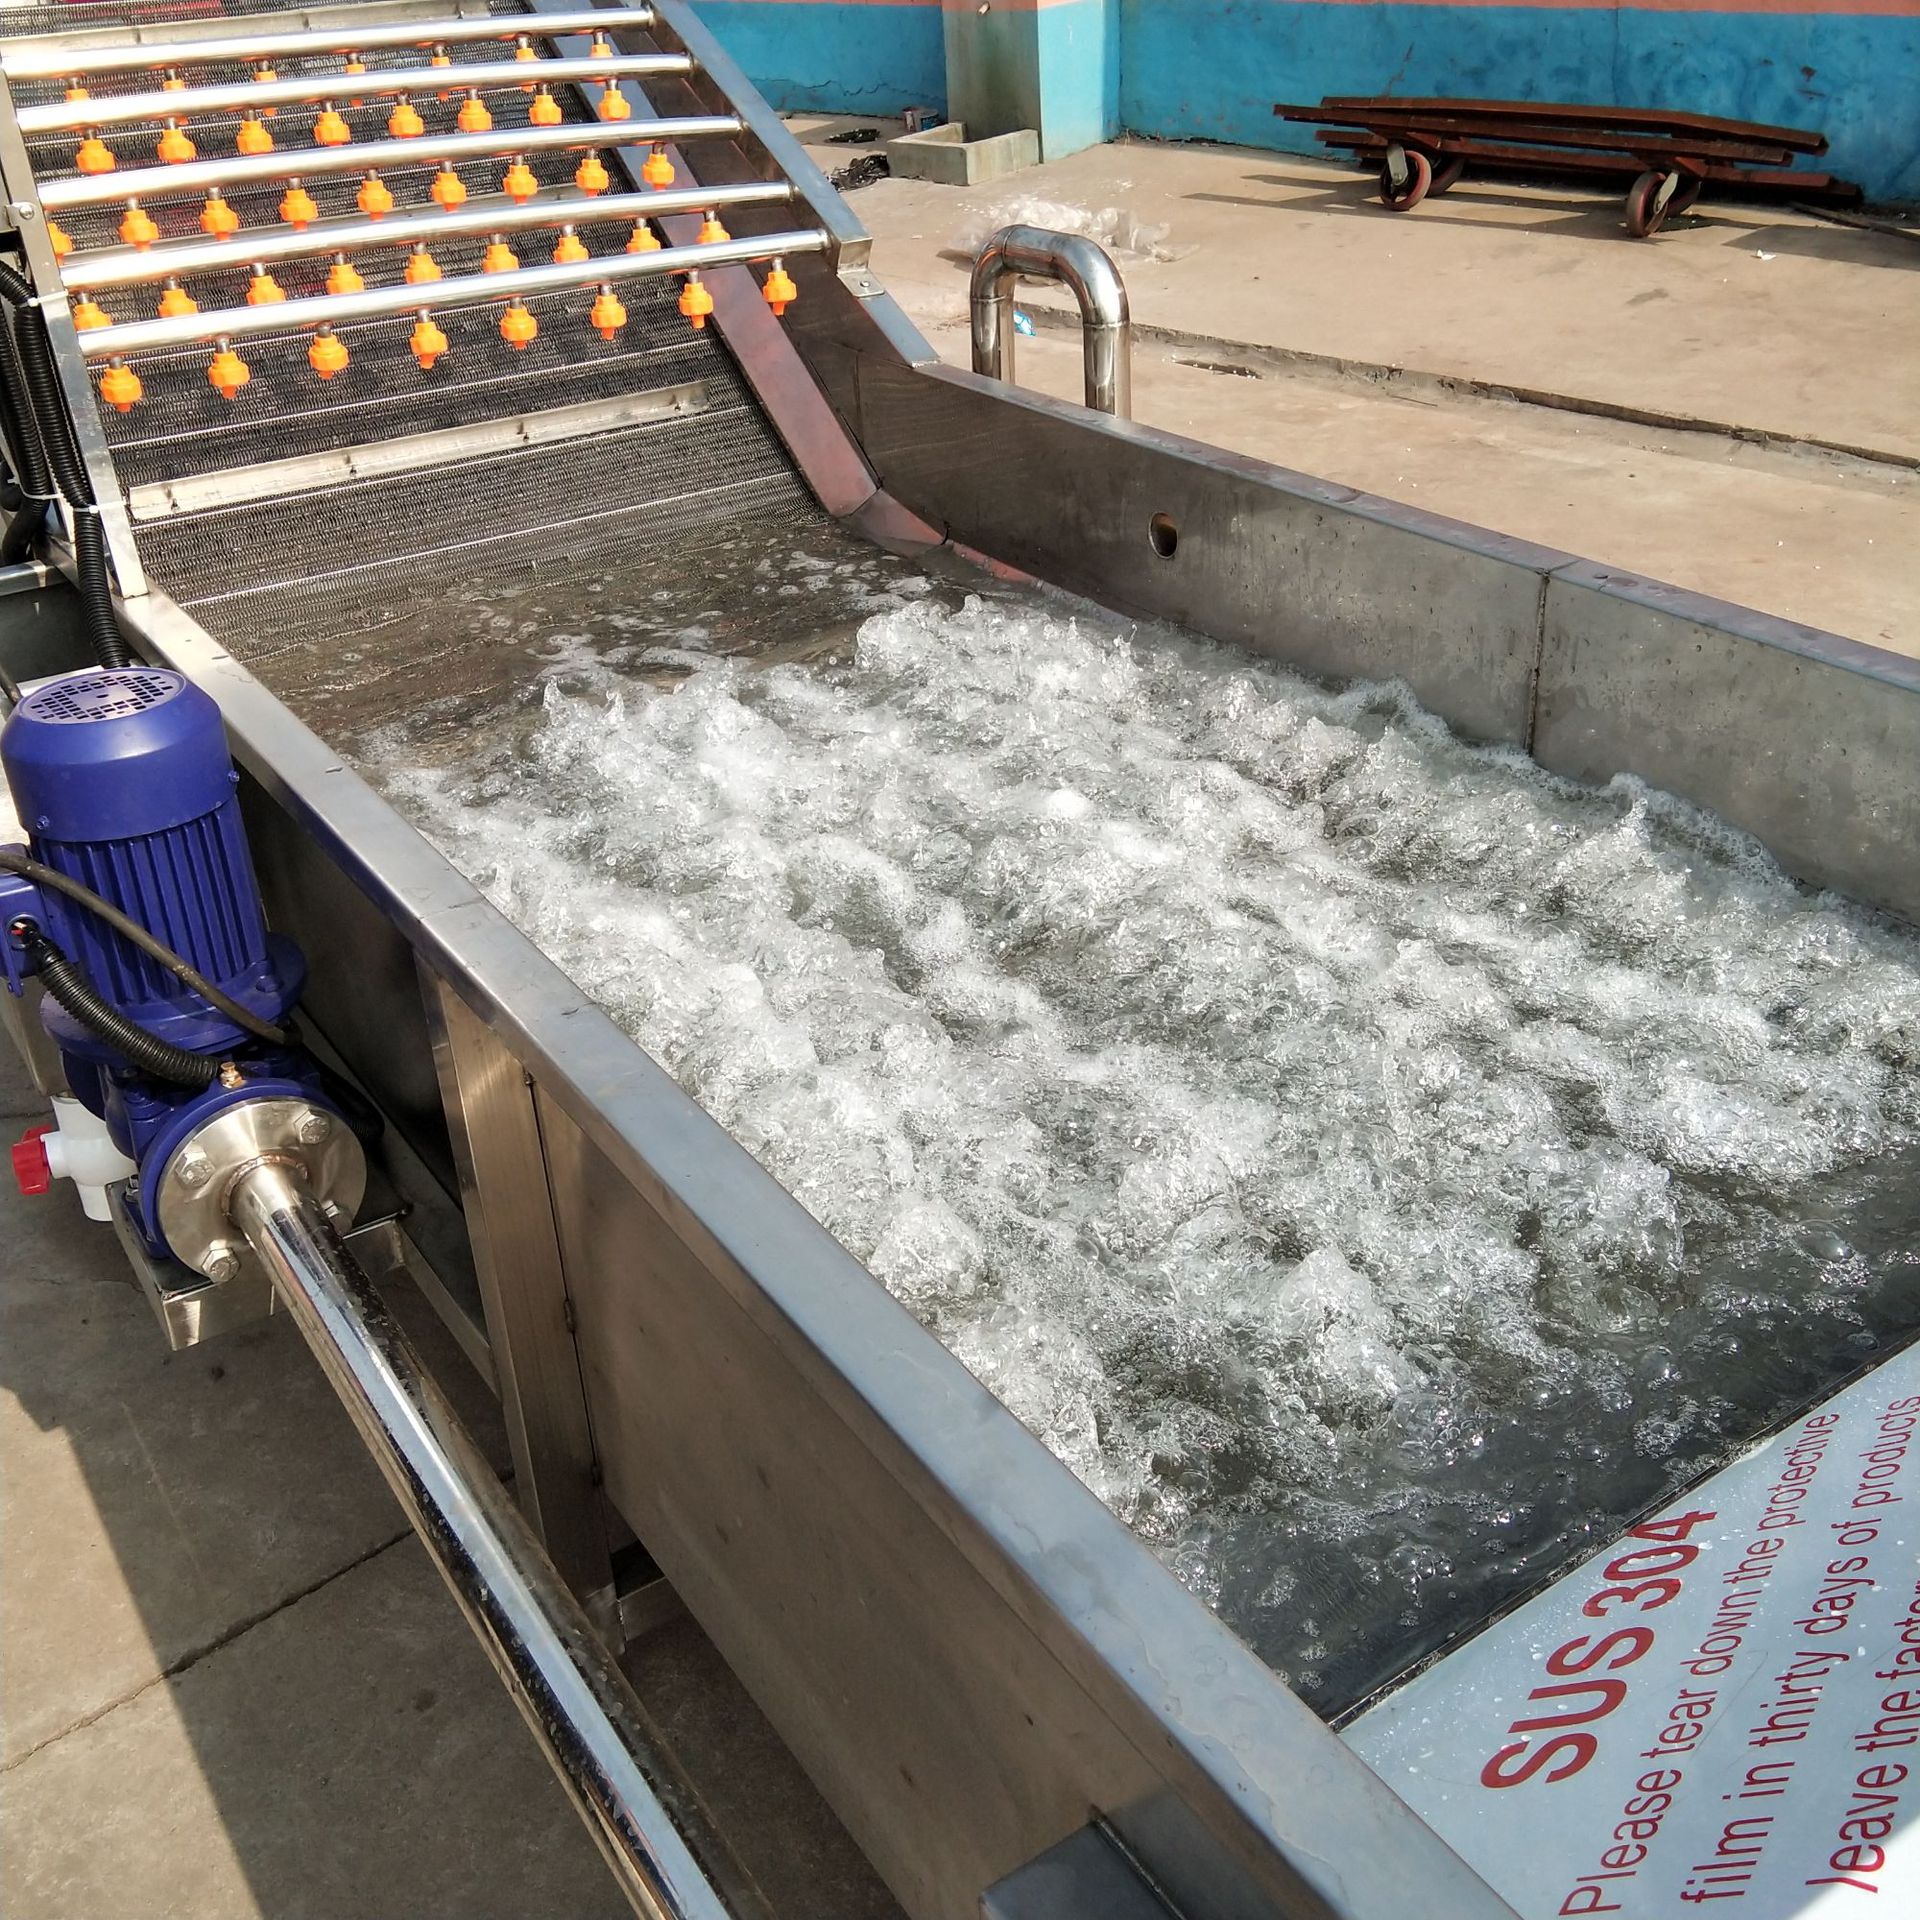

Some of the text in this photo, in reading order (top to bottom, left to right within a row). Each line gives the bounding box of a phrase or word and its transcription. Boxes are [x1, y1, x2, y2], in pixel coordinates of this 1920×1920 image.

[1480, 1510, 1717, 1789] SUS 304
[1558, 1413, 1840, 1916] Please tear down the protective
[1679, 1395, 1920, 1904] film in thirty days of products
[1854, 1689, 1920, 1753] the
[1805, 1762, 1909, 1894] leave
